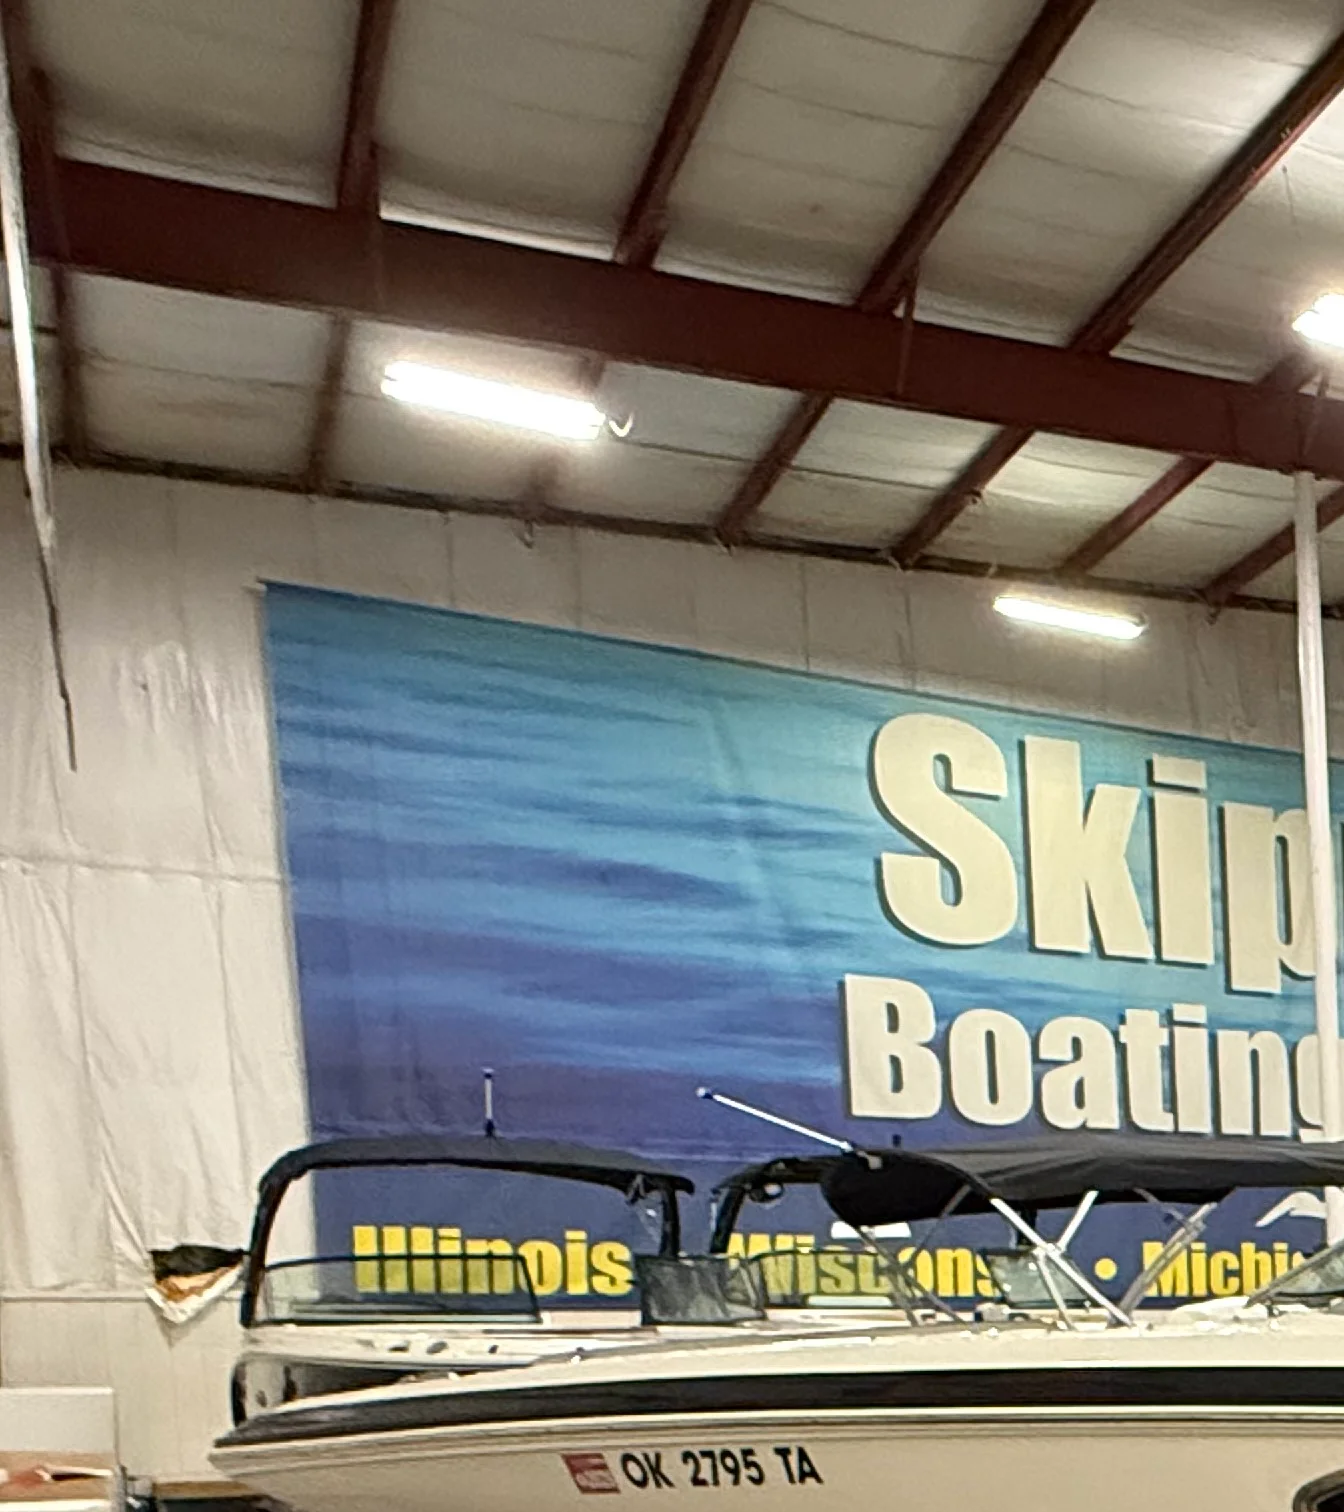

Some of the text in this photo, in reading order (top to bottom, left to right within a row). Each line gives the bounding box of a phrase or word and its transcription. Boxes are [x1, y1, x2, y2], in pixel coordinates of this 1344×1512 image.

[353, 1224, 635, 1297] Illinois
[620, 1445, 824, 1489] OK 2795 TA
